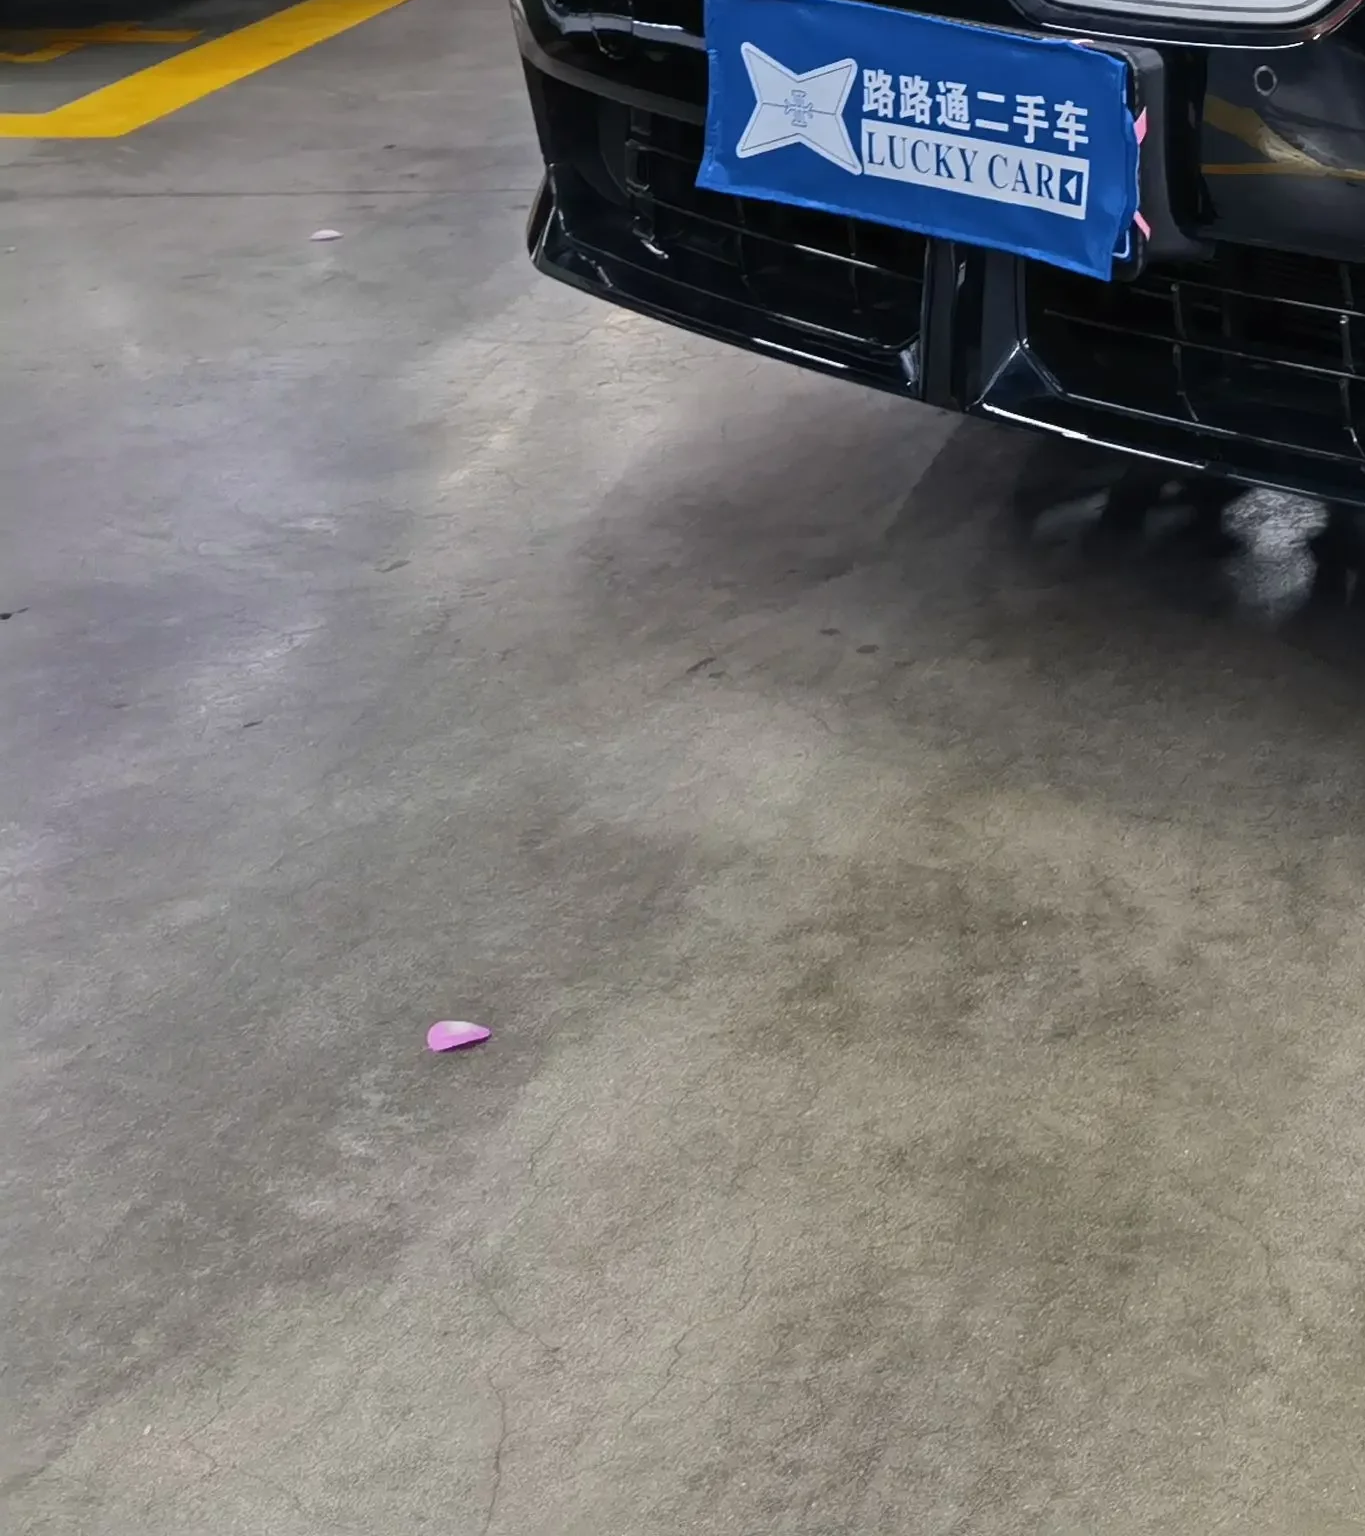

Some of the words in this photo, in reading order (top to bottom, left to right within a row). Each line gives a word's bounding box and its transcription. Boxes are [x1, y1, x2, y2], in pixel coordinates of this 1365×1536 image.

[862, 68, 1089, 153] 路路通二手车
[865, 131, 979, 184] LUCKY
[987, 152, 1056, 201] CAR
